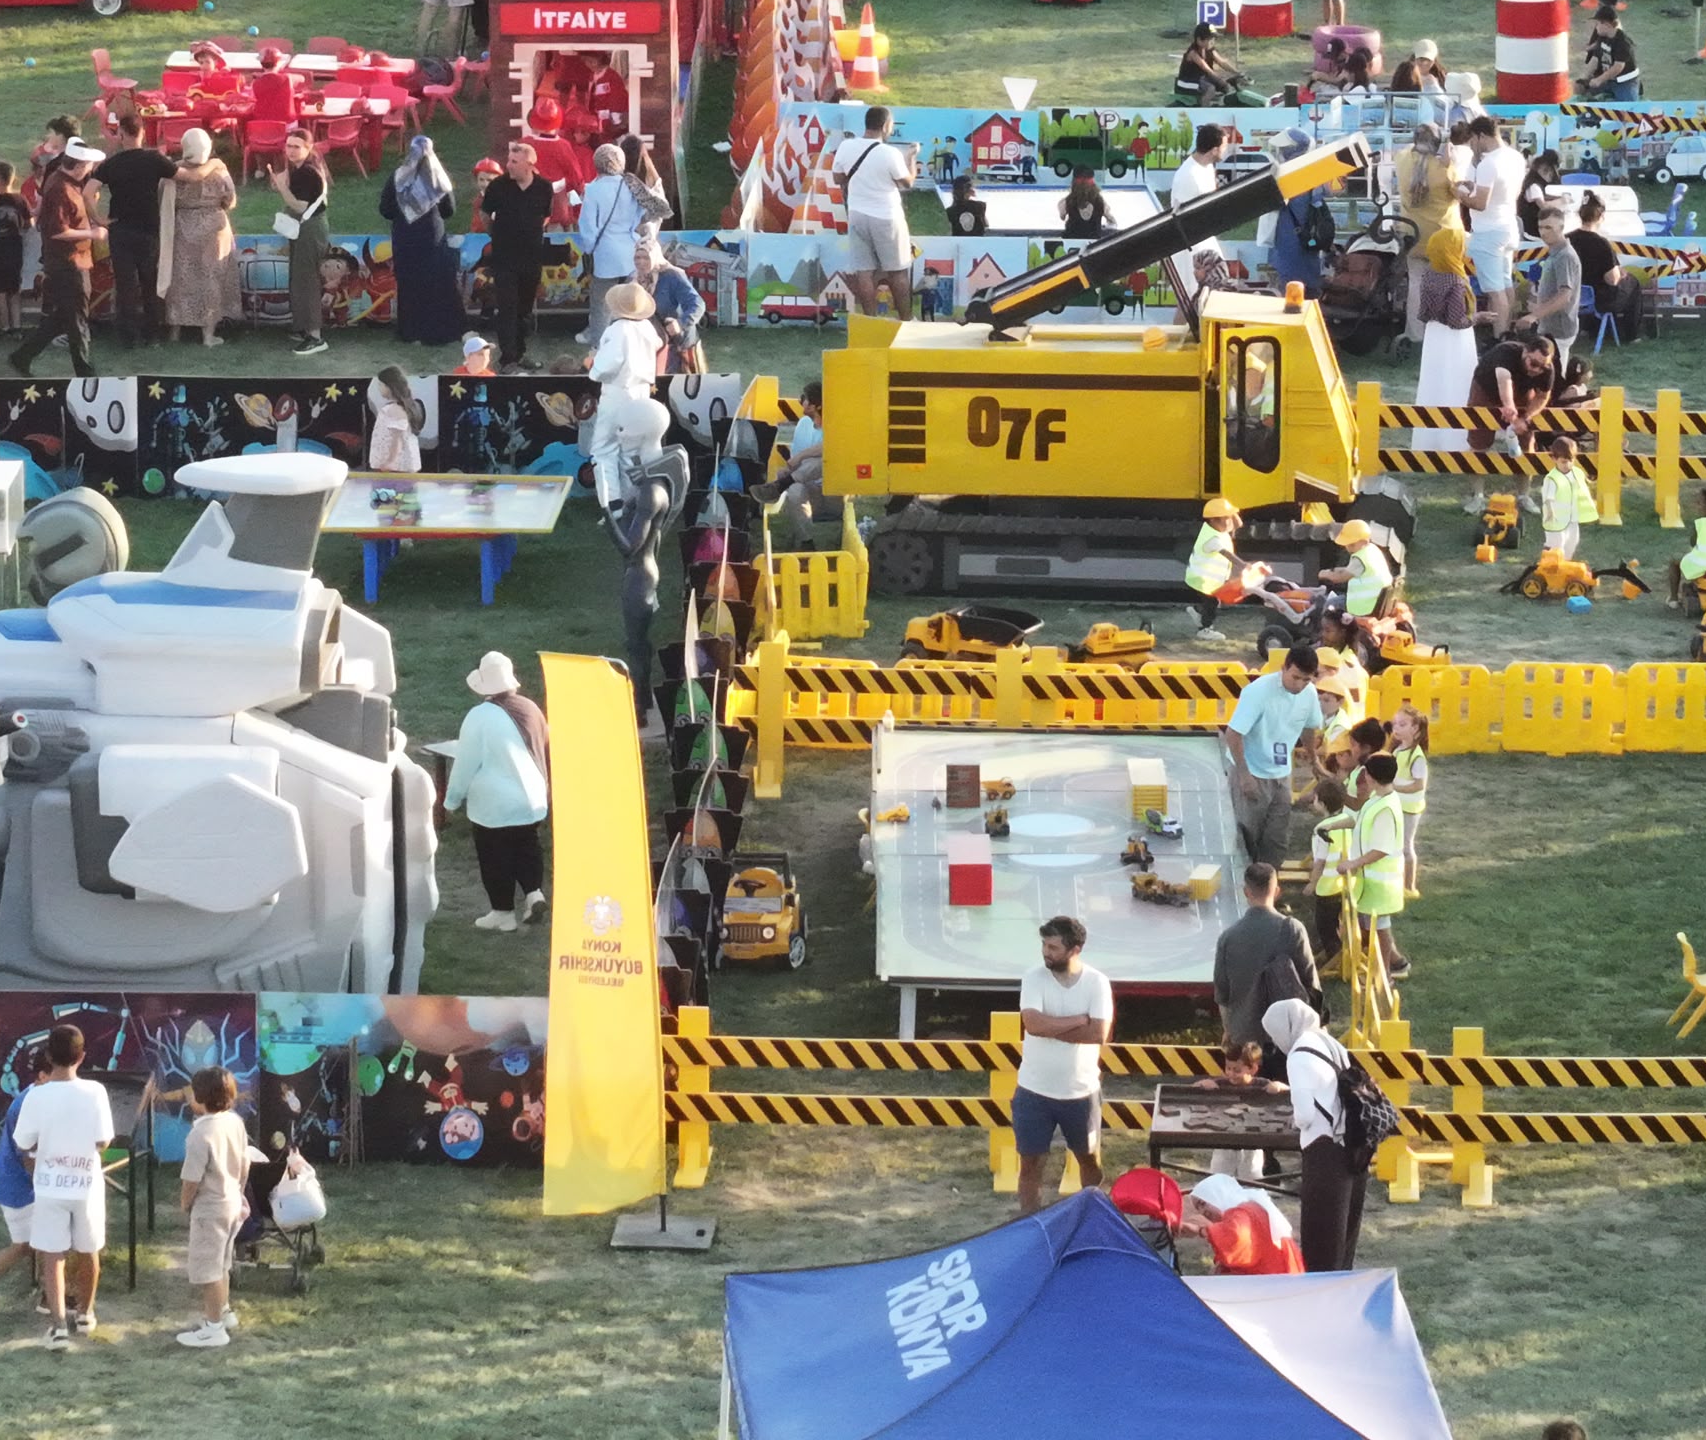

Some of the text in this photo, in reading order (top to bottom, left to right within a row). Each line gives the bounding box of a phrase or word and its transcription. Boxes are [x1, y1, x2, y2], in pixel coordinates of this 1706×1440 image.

[533, 8, 628, 29] İTFAİYE
[1204, 3, 1220, 23] P
[967, 395, 1067, 462] 07F
[885, 1274, 952, 1381] KONYA
